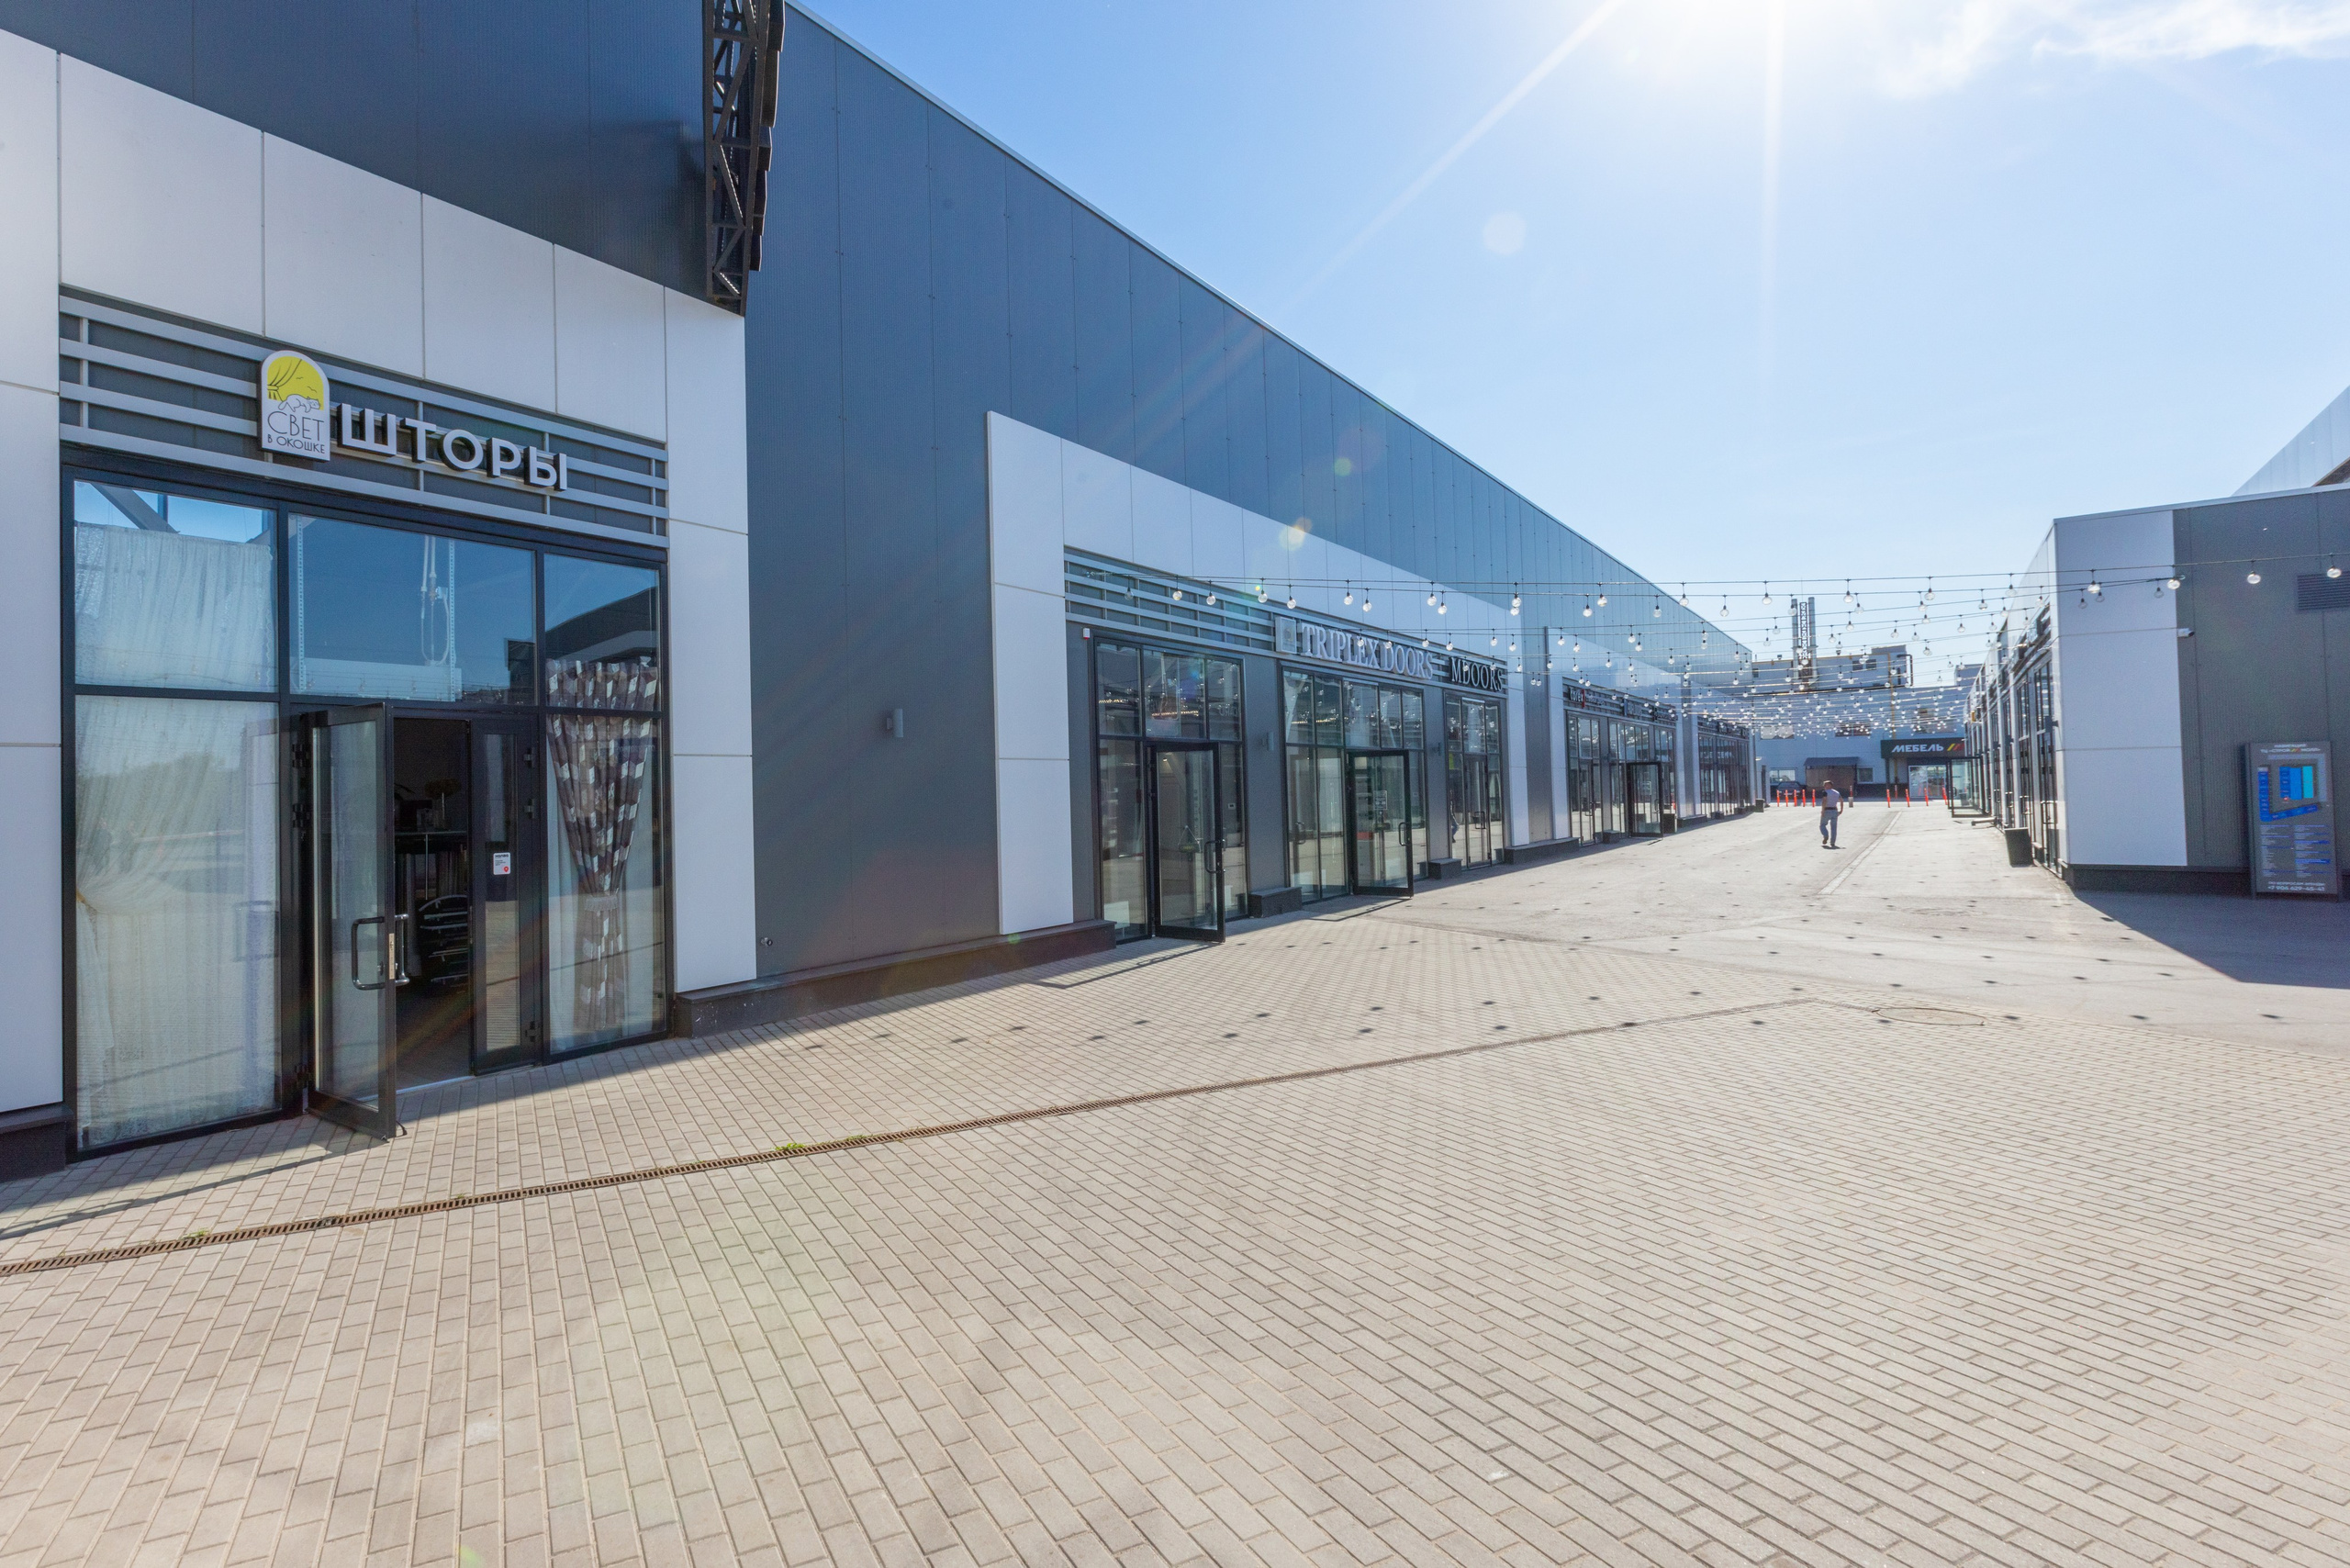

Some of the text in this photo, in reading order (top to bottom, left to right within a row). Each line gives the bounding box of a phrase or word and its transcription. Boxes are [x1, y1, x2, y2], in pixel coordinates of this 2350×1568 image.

[267, 410, 325, 442] СВЕТ
[276, 436, 325, 454] ОКОШКЕ
[338, 402, 568, 492] ШТОРЫ
[1300, 622, 1433, 680] TRIPLEX DOORS
[1450, 656, 1503, 692] MDOORS
[1891, 744, 1944, 753] МЕБЕЛЬ
